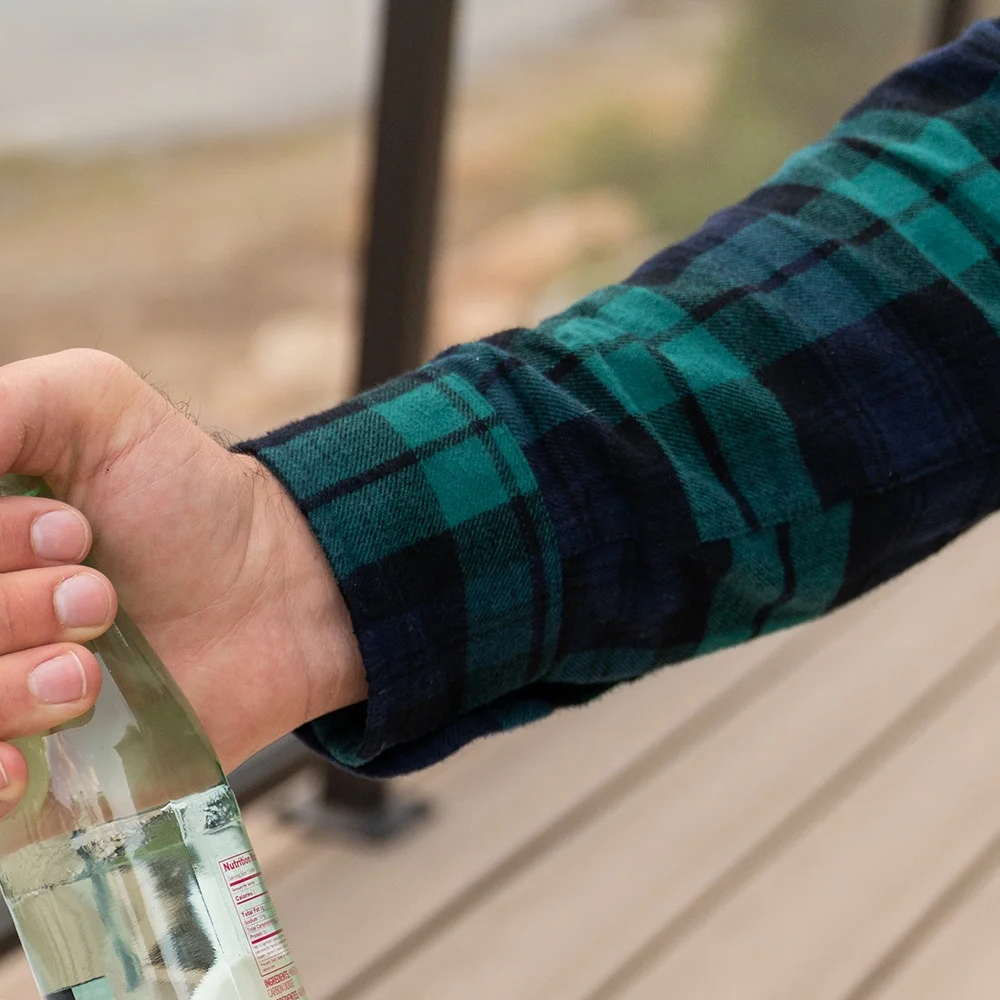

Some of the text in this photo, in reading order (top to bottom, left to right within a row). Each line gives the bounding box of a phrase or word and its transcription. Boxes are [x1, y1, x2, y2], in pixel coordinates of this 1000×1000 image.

[223, 856, 252, 872] Nutrition
[235, 891, 253, 901] Calories
[241, 908, 253, 918] Total
